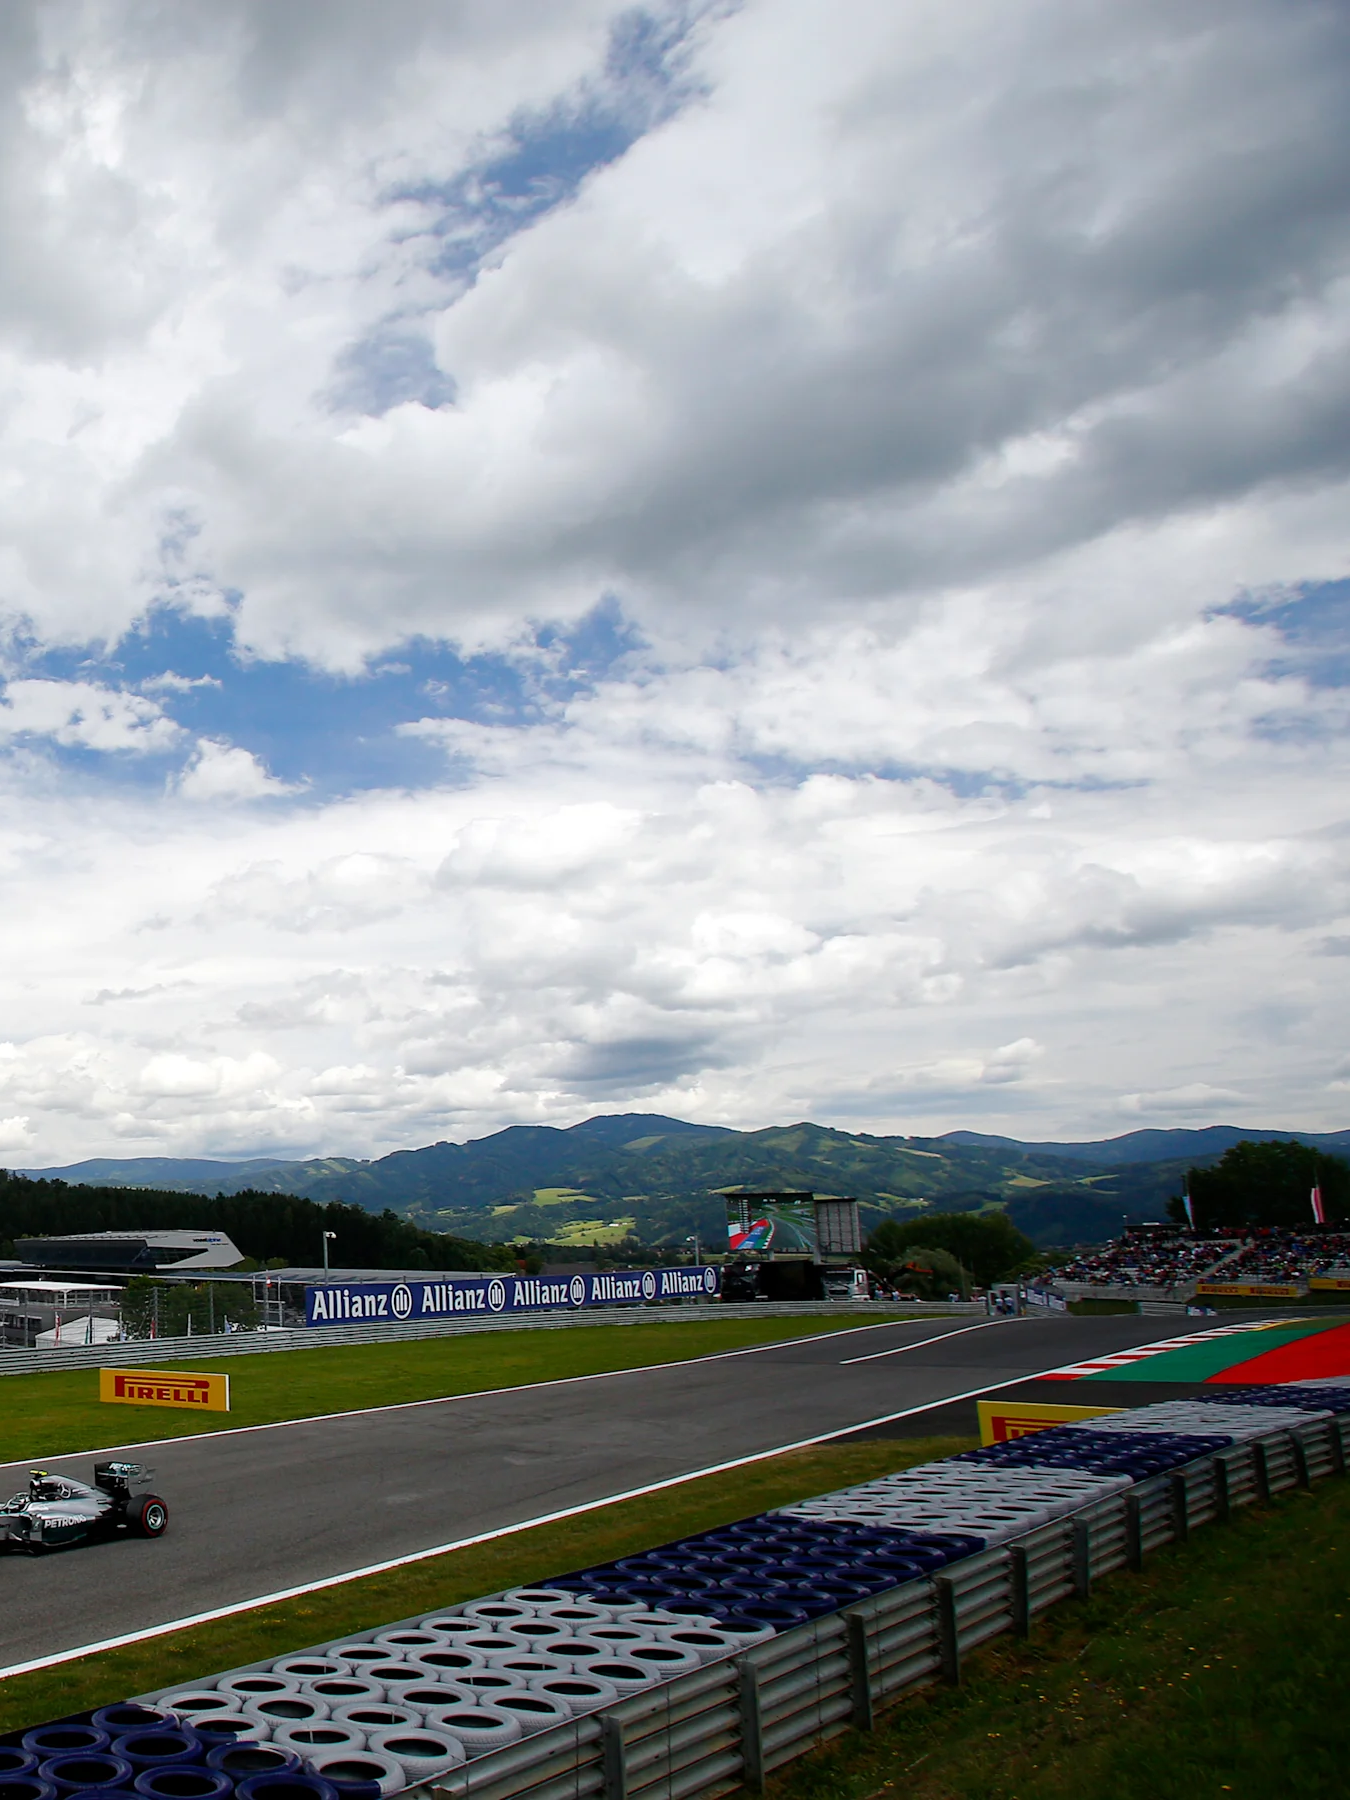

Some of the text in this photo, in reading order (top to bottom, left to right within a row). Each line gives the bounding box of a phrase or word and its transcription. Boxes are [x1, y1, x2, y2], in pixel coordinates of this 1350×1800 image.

[312, 1271, 704, 1320] Allianz Allianz Allianz Allianz Allianz
[115, 1376, 210, 1404] PIRELLI
[44, 1514, 87, 1529] PETRONAS
